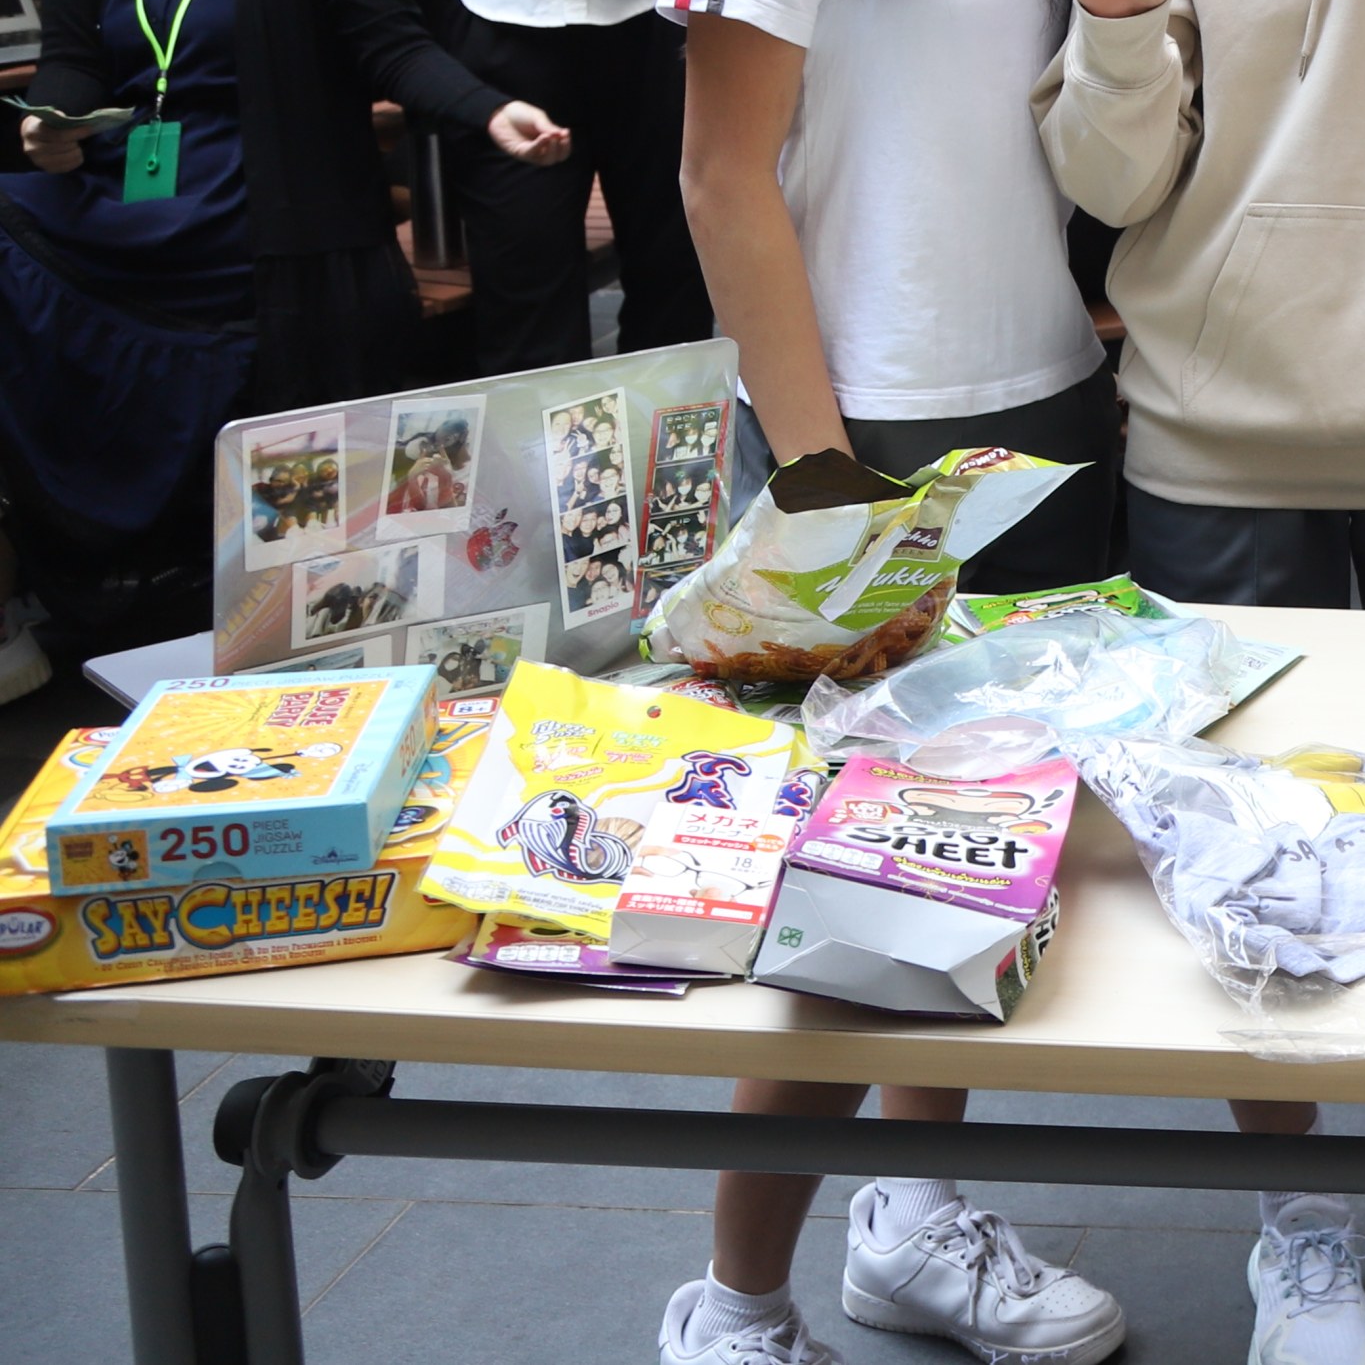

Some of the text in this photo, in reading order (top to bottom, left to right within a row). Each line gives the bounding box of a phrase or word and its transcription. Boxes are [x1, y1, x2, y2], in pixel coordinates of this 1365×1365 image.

[165, 678, 230, 691] 250
[686, 813, 760, 830] メガネ
[159, 819, 289, 862] 250 PIECE
[253, 831, 302, 843] JIGSAW
[254, 842, 303, 855] PUZZLE
[734, 856, 753, 869] 18
[86, 897, 174, 957] SAY
